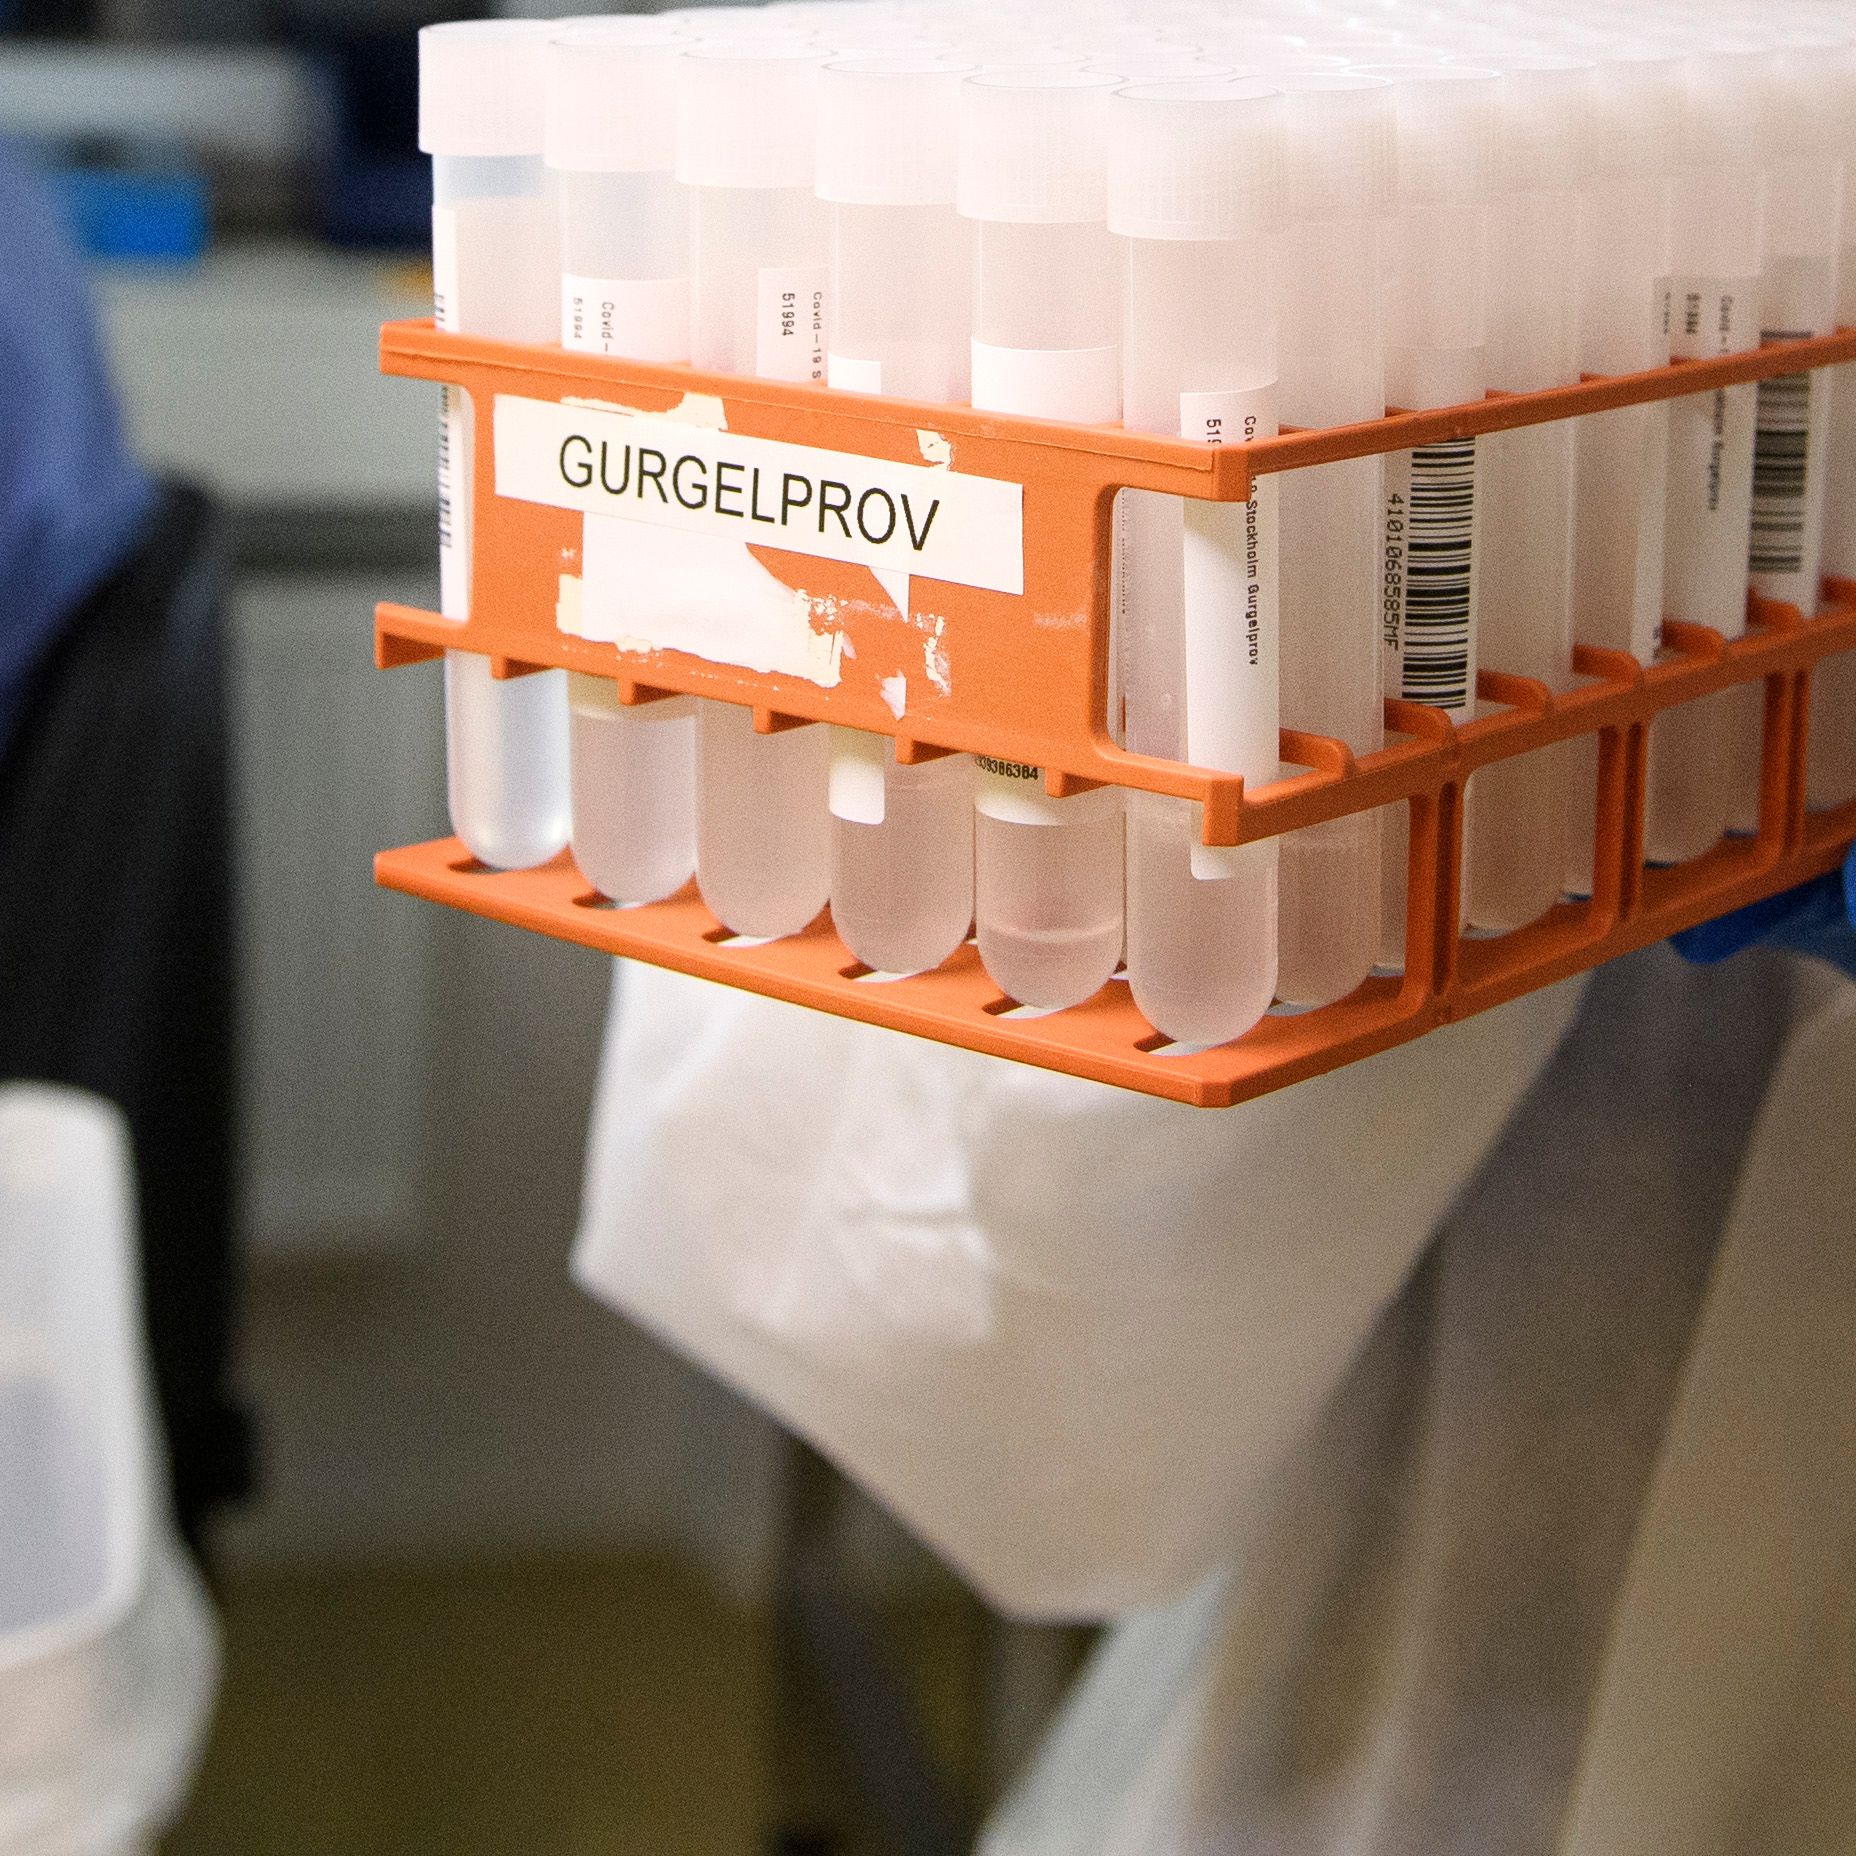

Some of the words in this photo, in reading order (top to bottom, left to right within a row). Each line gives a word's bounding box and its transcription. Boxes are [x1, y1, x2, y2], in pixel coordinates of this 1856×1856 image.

[601, 301, 615, 352] Covid-
[781, 293, 795, 336] 51994
[559, 434, 940, 552] GURGELPROV
[1246, 500, 1259, 578] Stockholm
[1383, 493, 1404, 651] 4101068585MF
[1245, 584, 1260, 665] Gurgelprov
